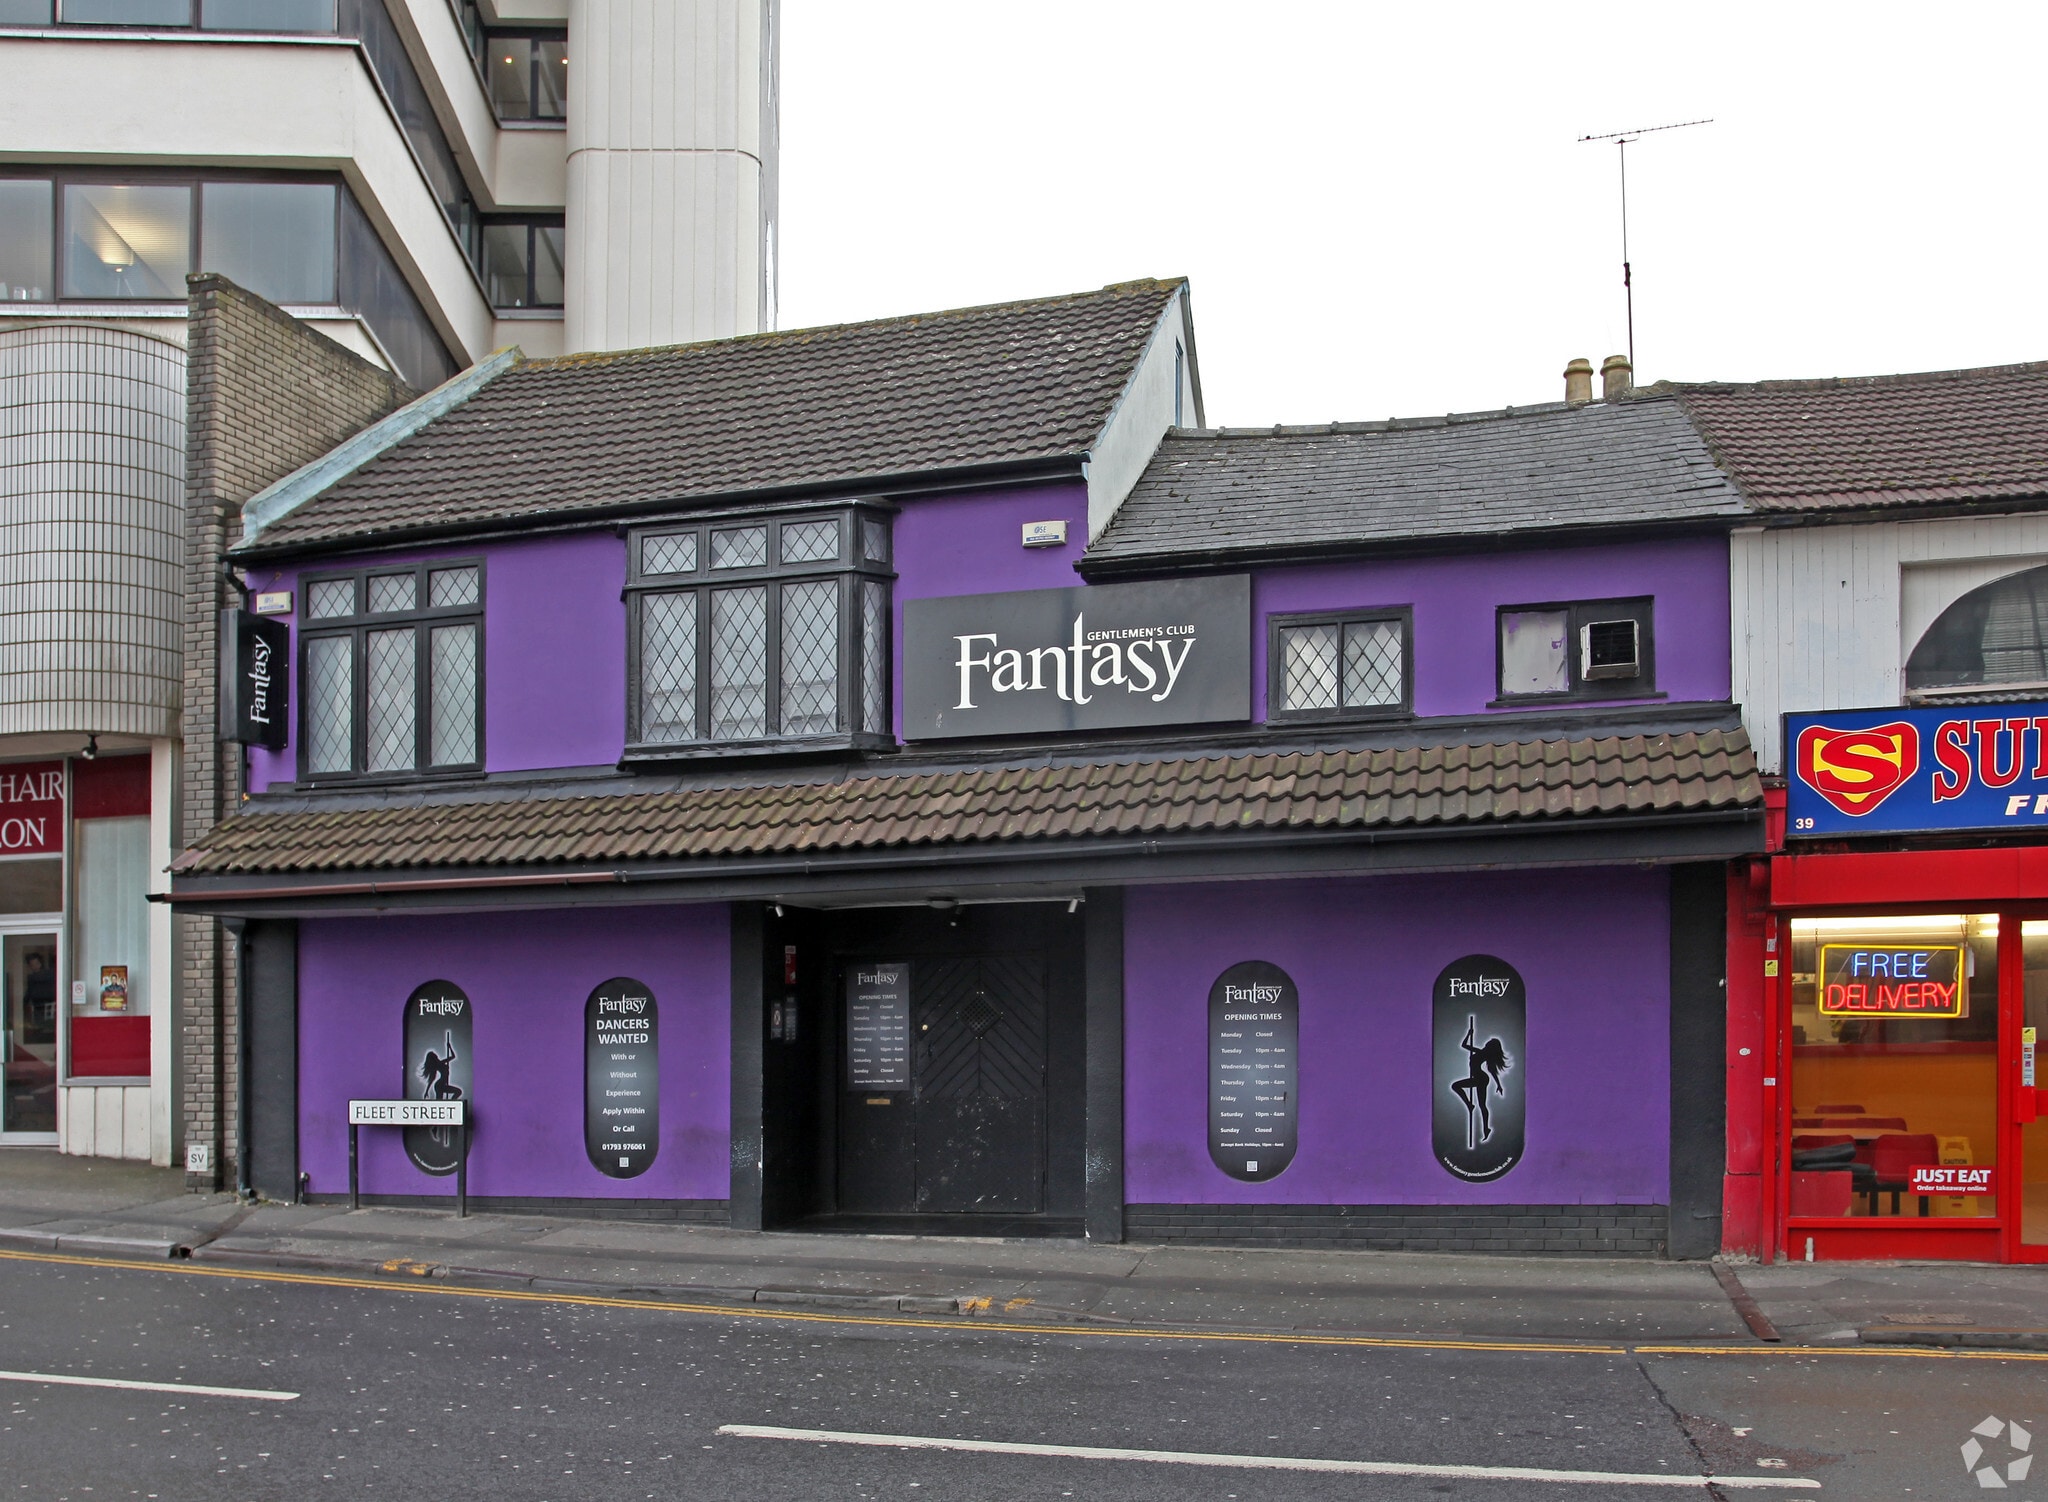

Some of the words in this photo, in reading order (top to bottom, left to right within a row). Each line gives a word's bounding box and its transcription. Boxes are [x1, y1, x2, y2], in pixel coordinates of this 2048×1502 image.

[1087, 627, 1163, 640] GENTLEMEN'S
[1166, 625, 1195, 635] CLUB
[952, 612, 1196, 710] Fantasy
[248, 634, 271, 724] Fantasy
[0, 817, 46, 848] ON
[1795, 819, 1814, 829] 39
[1853, 953, 1928, 978] FREE
[858, 971, 898, 985] Fantasy
[1449, 974, 1510, 997] Fantasy
[1225, 982, 1282, 1003] Fantasy
[1826, 982, 1957, 1010] DELIVERY
[419, 996, 464, 1016] Fantasy
[599, 994, 646, 1014] Fantasy
[597, 1019, 649, 1030] DANCERS
[598, 1033, 648, 1044] WANTED
[356, 1106, 396, 1119] FLEET
[402, 1106, 456, 1119] STREET
[191, 1154, 204, 1163] SV
[1913, 1169, 1955, 1183] JUST
[1958, 1170, 1991, 1183] EAT
